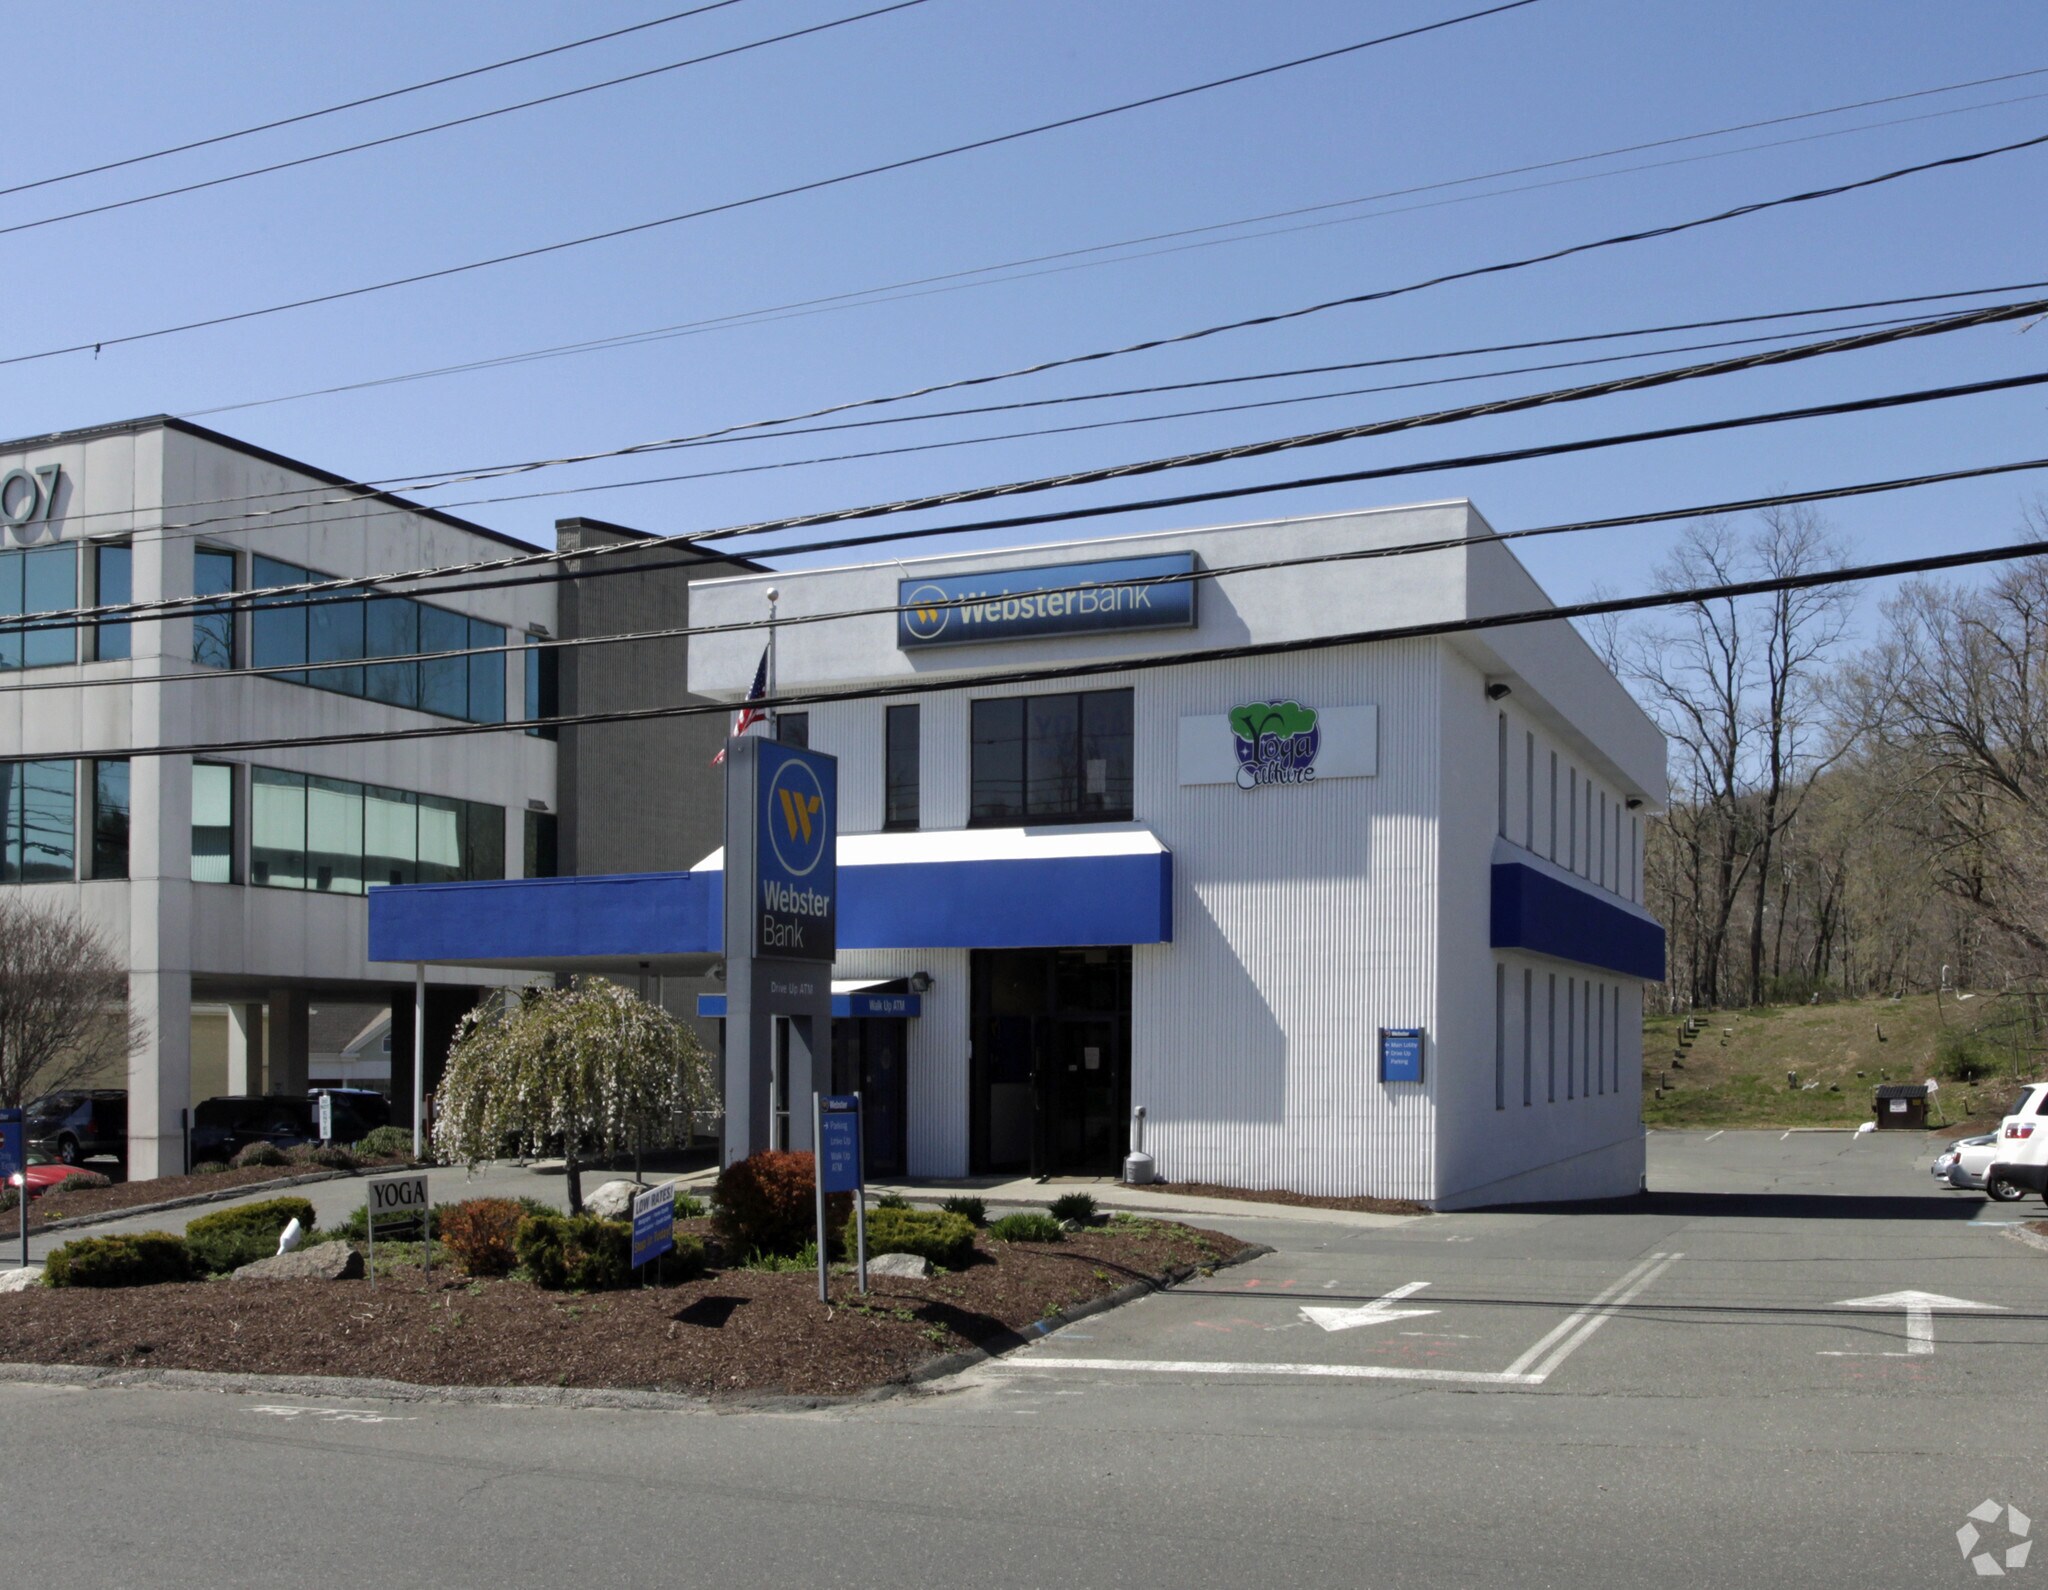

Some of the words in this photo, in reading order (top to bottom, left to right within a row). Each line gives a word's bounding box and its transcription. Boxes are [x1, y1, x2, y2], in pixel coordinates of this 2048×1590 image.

[1241, 713, 1314, 769] Yoga
[1236, 761, 1316, 790] Culture
[763, 880, 830, 917] Webster
[763, 914, 804, 948] Bank
[770, 982, 787, 993] Drive
[788, 983, 797, 996] Up
[799, 984, 814, 995] ATM
[869, 1000, 882, 1011] Walk
[883, 1000, 892, 1012] Up
[893, 1000, 906, 1011] ATM
[373, 1181, 425, 1208] YOGA
[635, 1197, 650, 1215] LOW
[651, 1186, 674, 1206] RATES!
